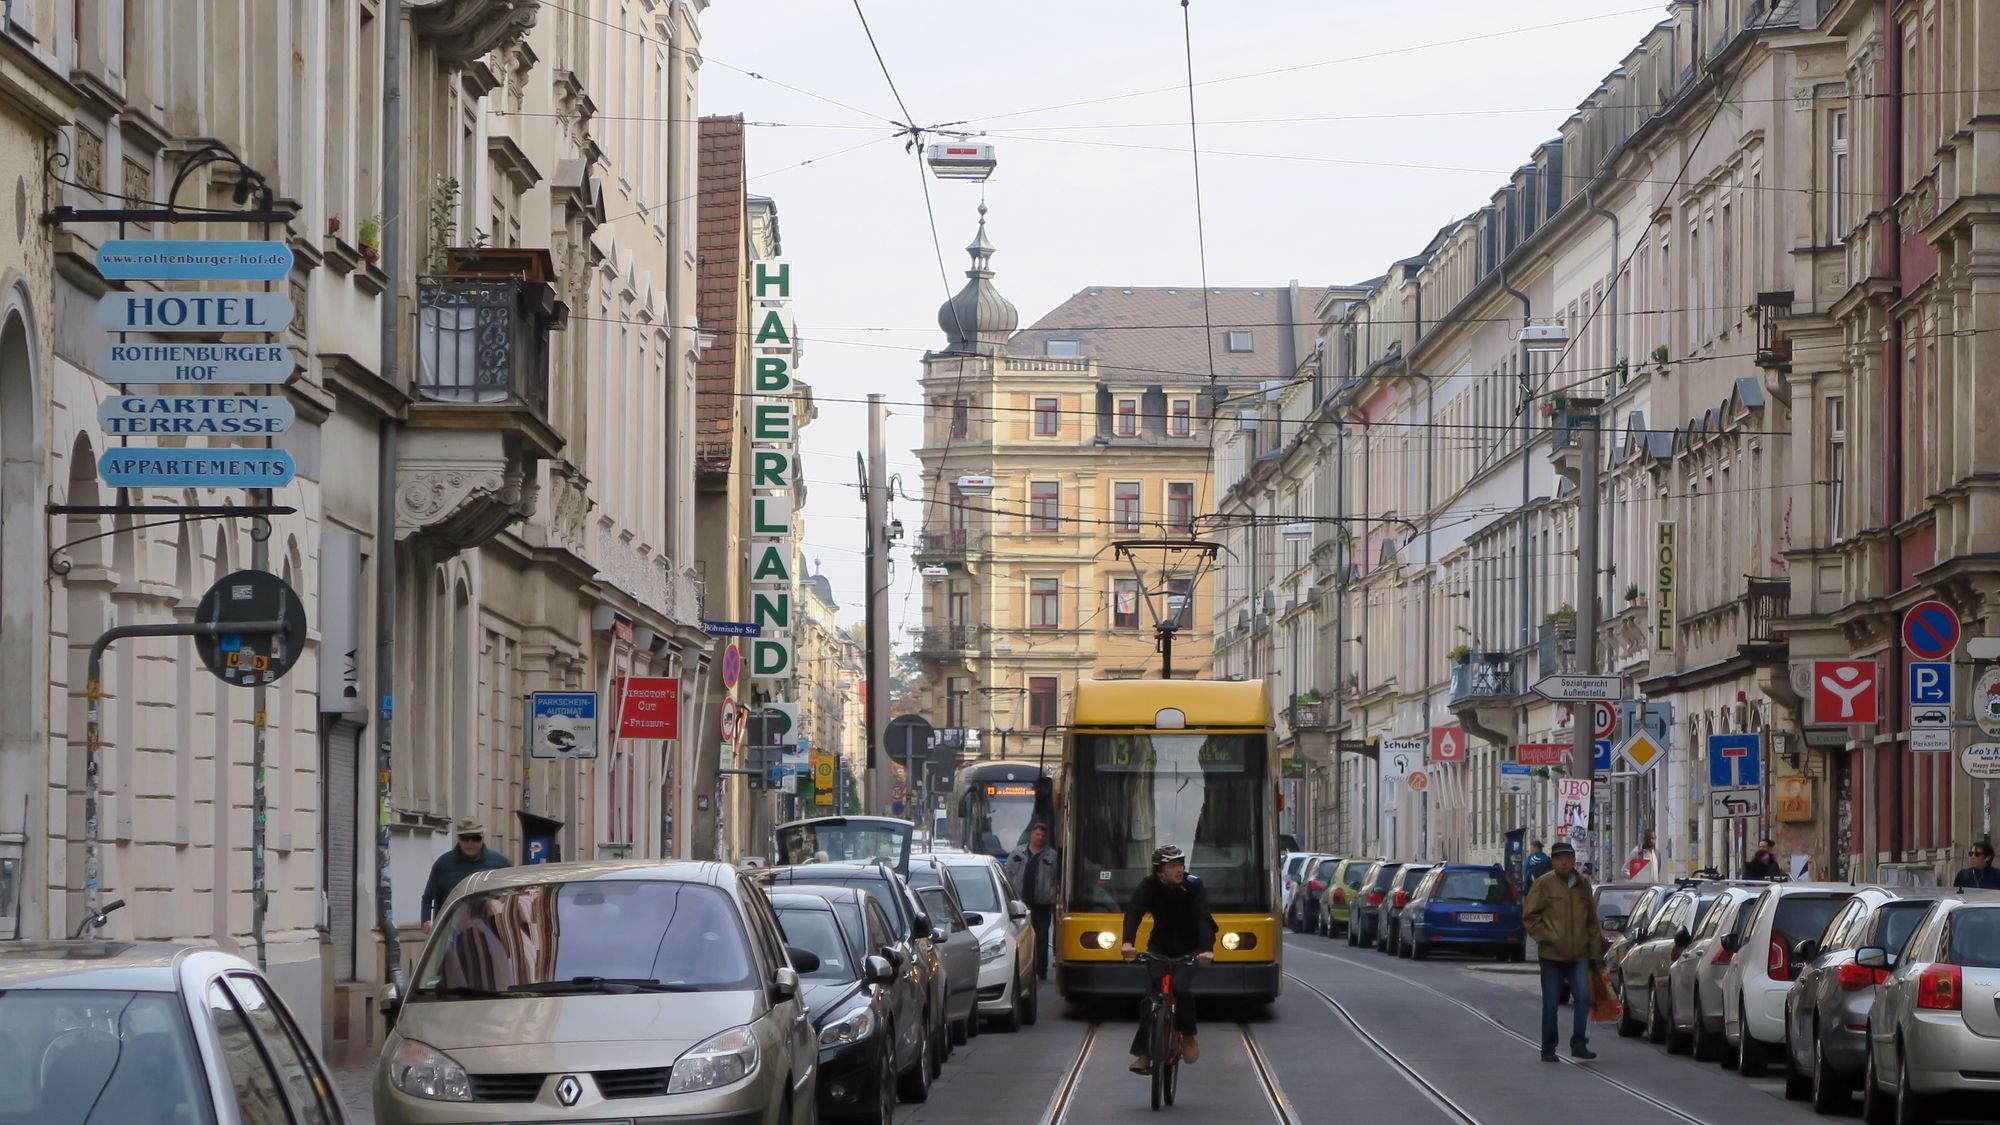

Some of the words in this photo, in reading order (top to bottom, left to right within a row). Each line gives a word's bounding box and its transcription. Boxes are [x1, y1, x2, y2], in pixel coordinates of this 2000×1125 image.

[103, 253, 285, 266] www.rothenburger-hof.de
[127, 297, 267, 326] HOTEL
[111, 346, 282, 362] ROTHENBURGER
[175, 365, 218, 380] HOF
[121, 398, 269, 414] GARTEN-
[107, 417, 284, 433] TERRASSE
[108, 459, 285, 475] APPARTEMENTS
[754, 263, 789, 674] HABERLAND
[1659, 524, 1673, 651] HOSTEL
[704, 624, 743, 634] Böhmische
[343, 648, 358, 698] DIVA
[1561, 679, 1608, 689] Sozialgericht
[1916, 668, 1939, 699] P
[1563, 689, 1606, 697] Außenstelle
[546, 707, 583, 716] AUTOMAT
[1383, 741, 1421, 749] Schuhe
[1968, 746, 1991, 755] Leo's
[1560, 780, 1590, 796] JBO
